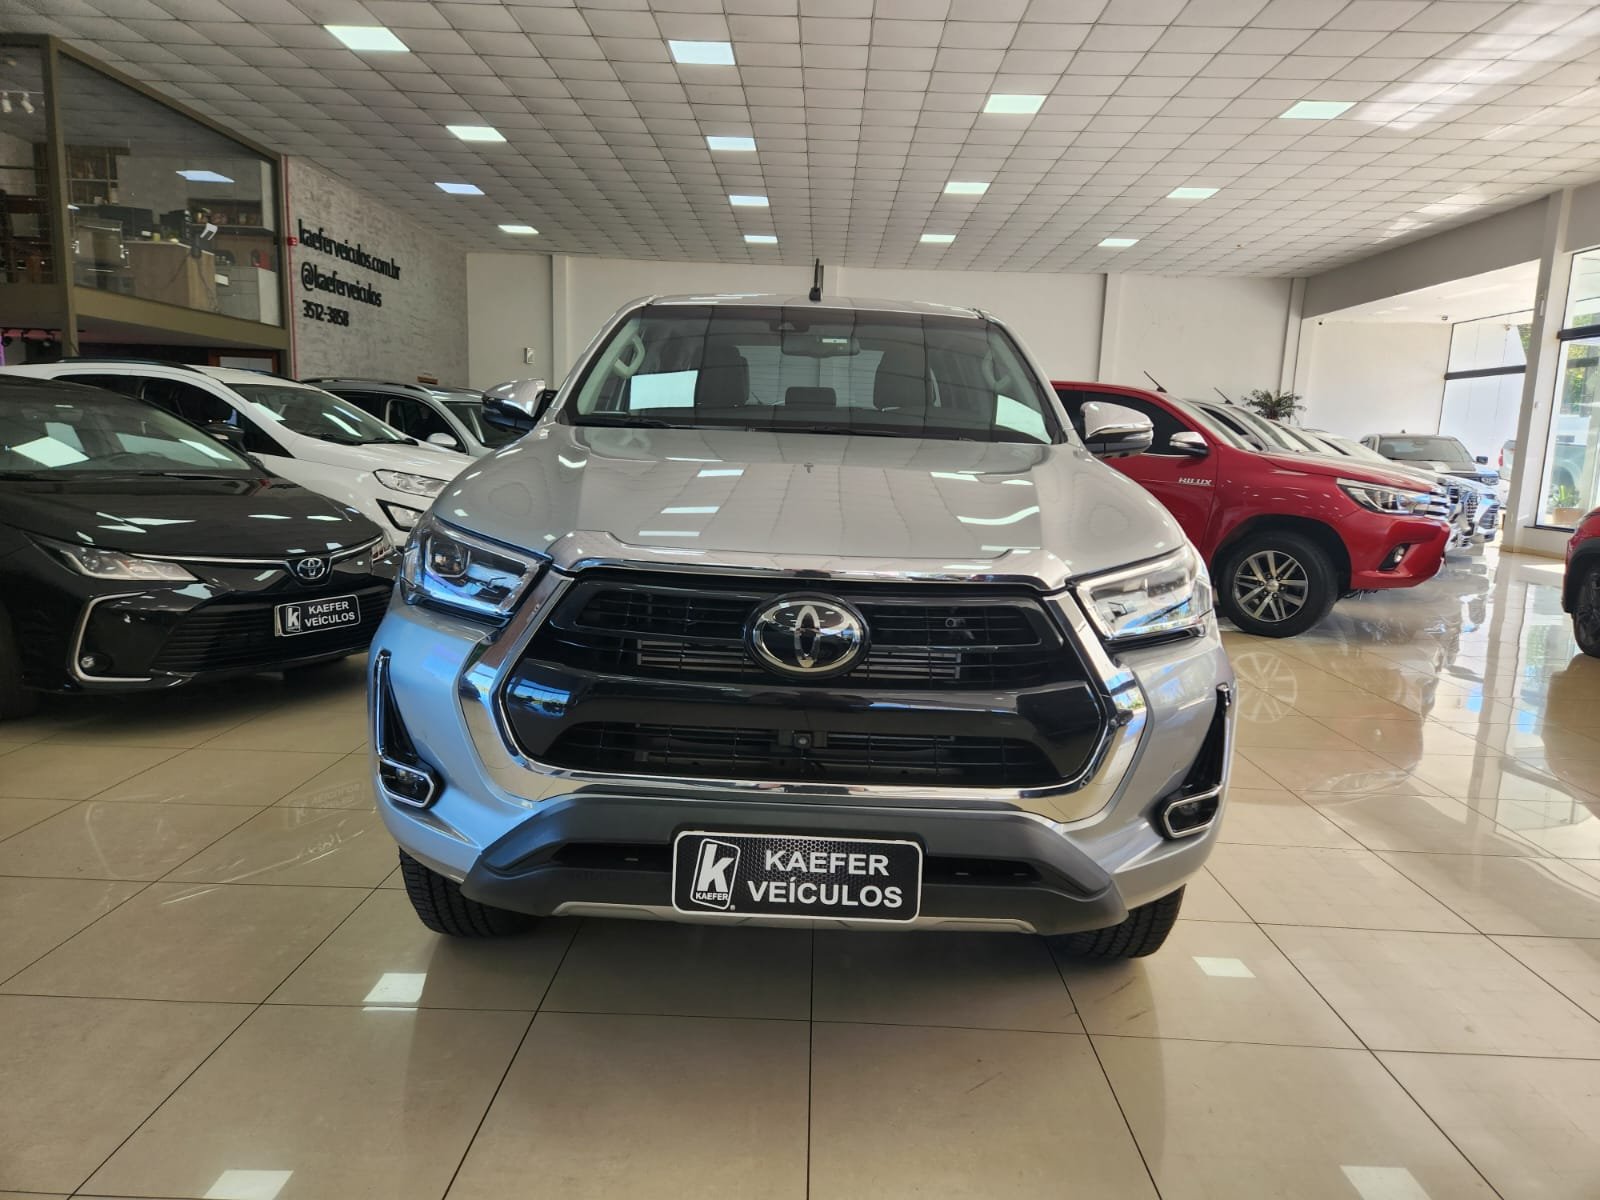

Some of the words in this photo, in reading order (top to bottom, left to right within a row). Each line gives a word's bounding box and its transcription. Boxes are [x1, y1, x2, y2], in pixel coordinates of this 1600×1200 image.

[302, 262, 382, 307] @kaeferveiculos
[1178, 477, 1212, 486] HILUX
[308, 601, 349, 614] KAEFER
[305, 611, 355, 627] VEÍCULOS
[765, 850, 889, 876] KAEFER
[695, 892, 729, 901] KAEFER
[747, 877, 903, 908] VEÍCULOS
